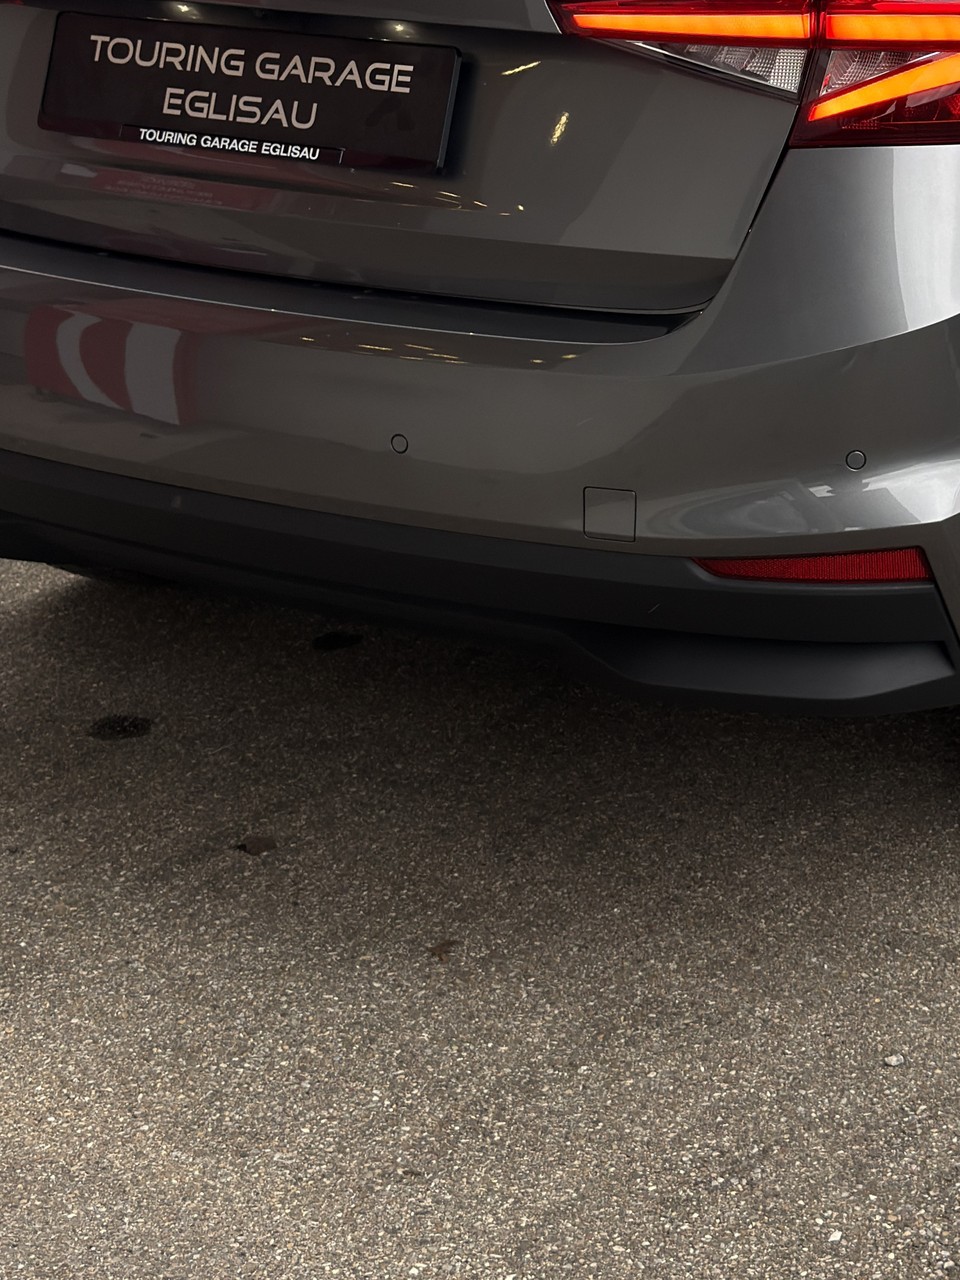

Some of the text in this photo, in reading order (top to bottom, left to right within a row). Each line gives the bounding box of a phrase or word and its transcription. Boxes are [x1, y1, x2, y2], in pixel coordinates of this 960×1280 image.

[90, 34, 414, 93] TOURING GARAGE
[162, 87, 317, 129] EGLISAU
[139, 128, 320, 160] TOURING GARAGE EGLISAU
